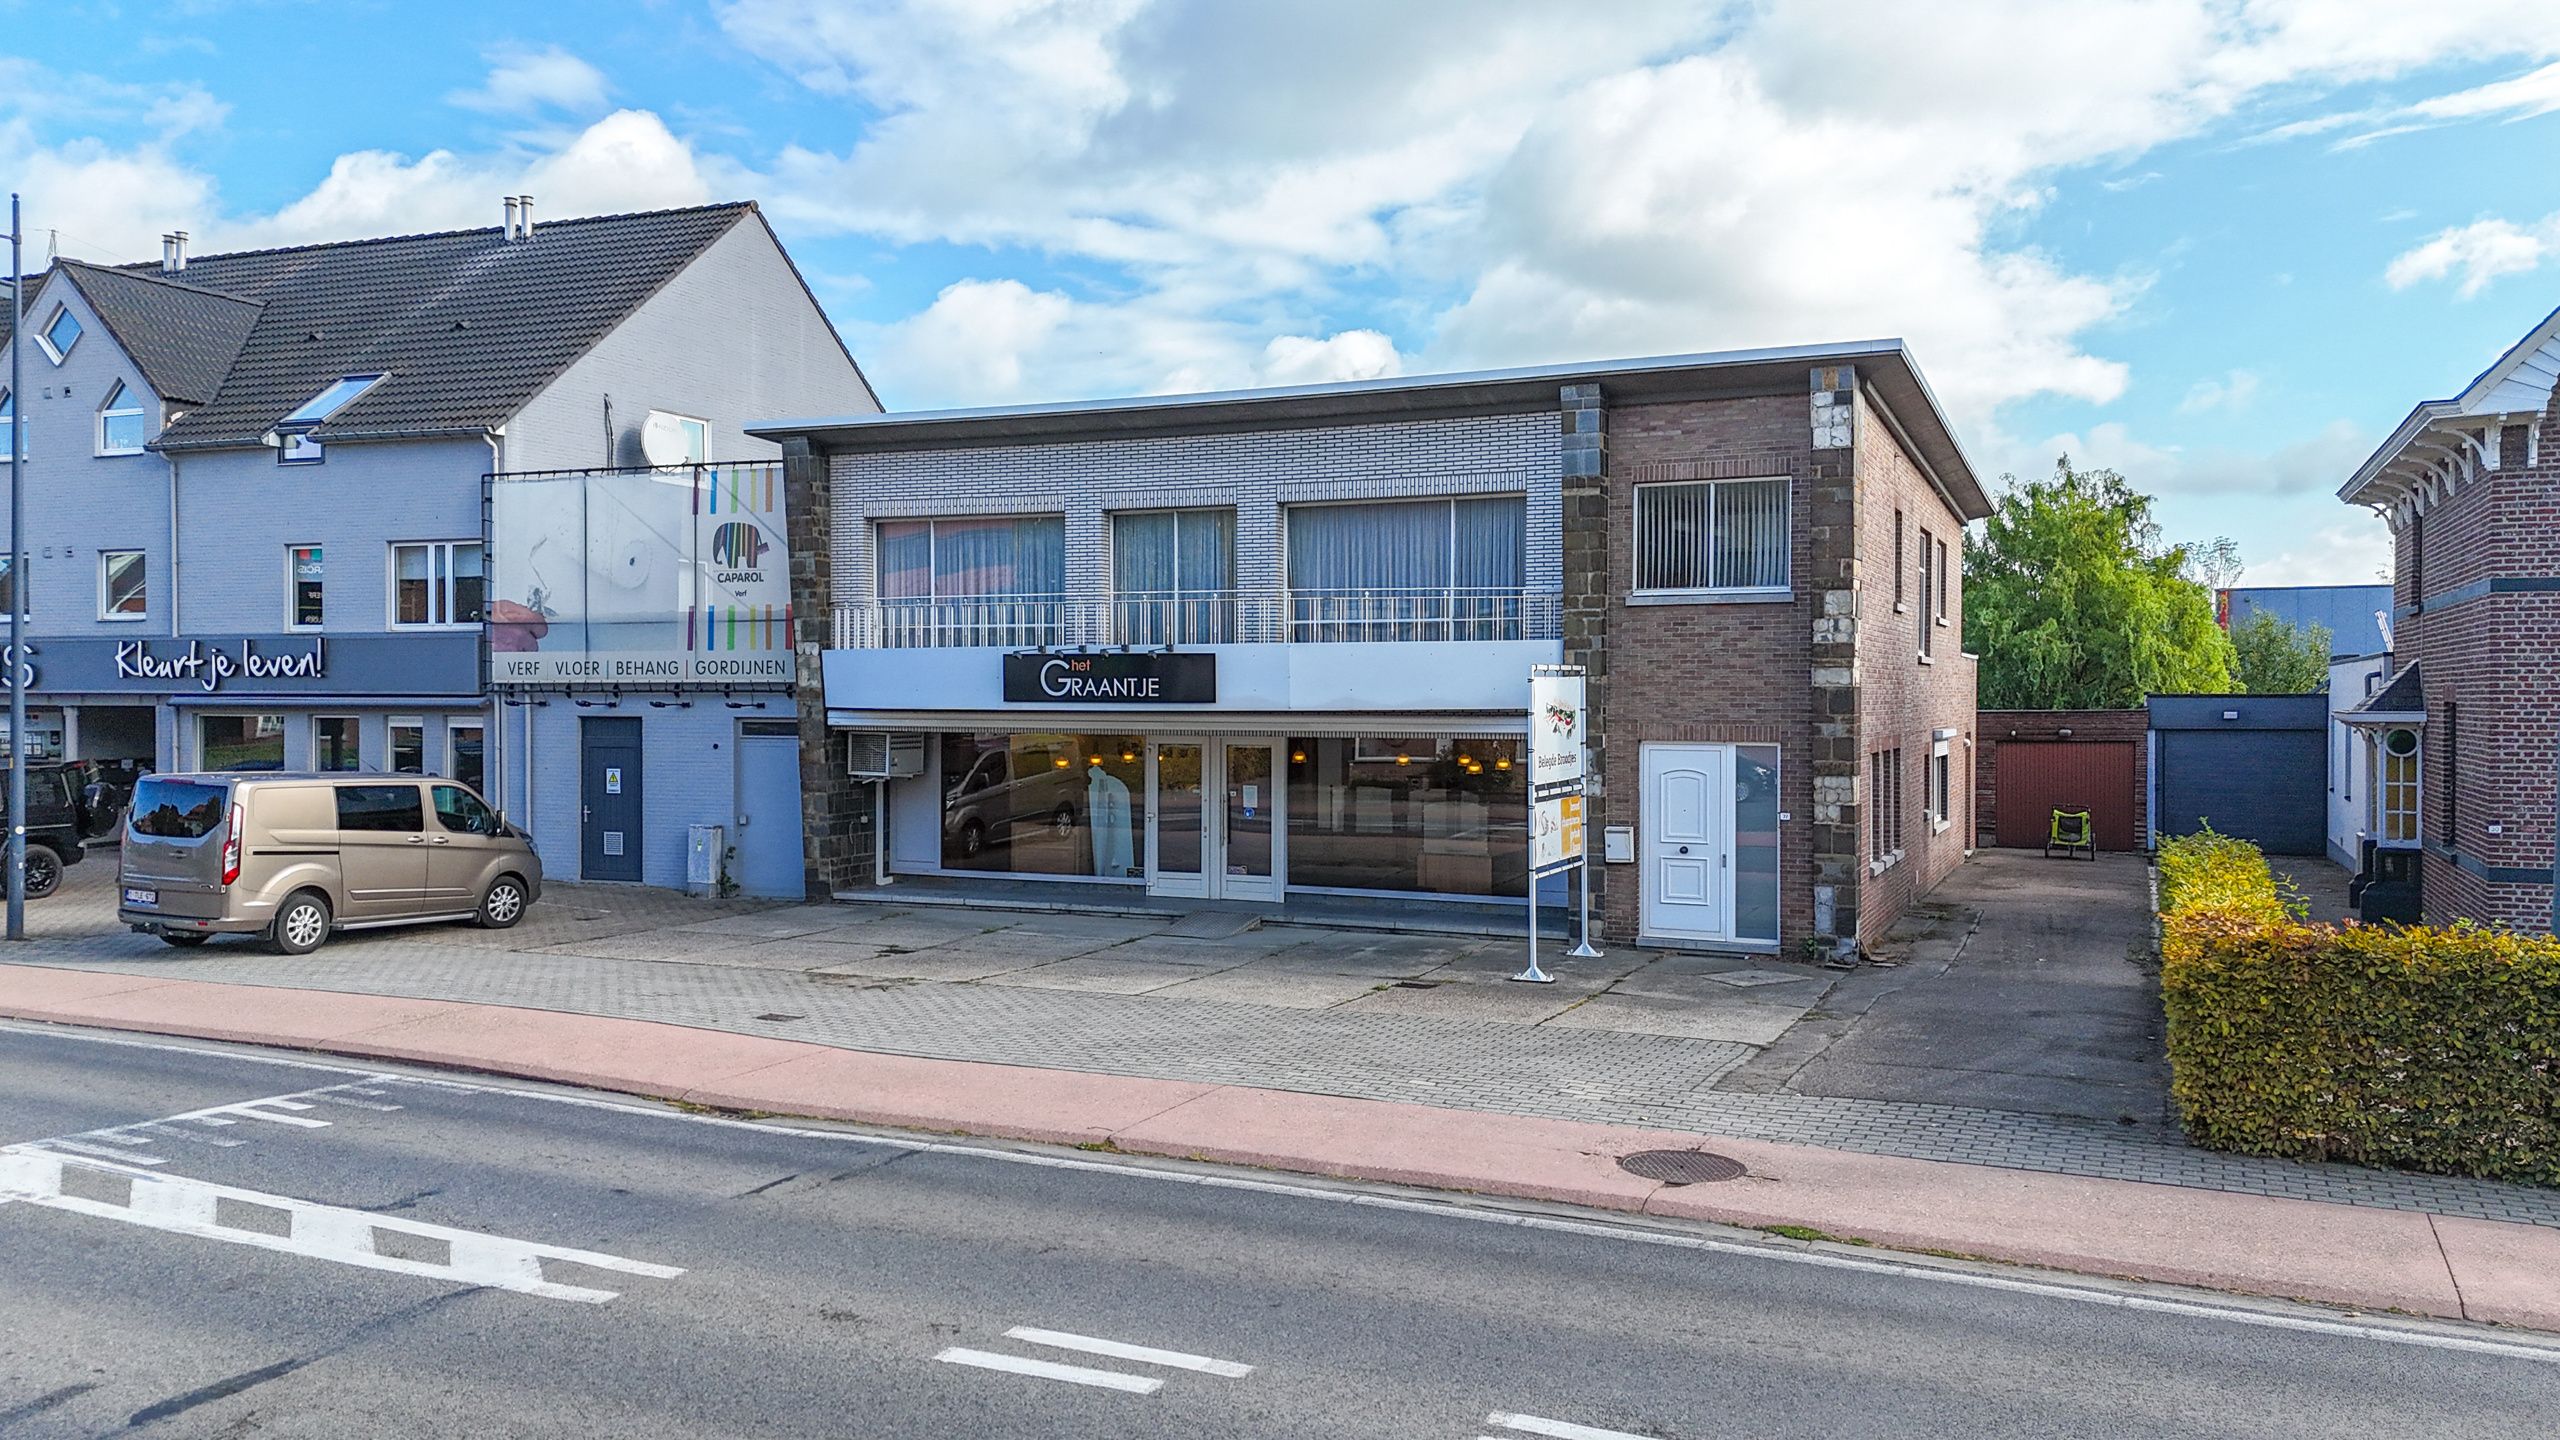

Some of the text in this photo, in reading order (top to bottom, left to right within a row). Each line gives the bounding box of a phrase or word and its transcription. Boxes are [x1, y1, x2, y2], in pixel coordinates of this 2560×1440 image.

[717, 572, 764, 583] CAPAROL
[115, 637, 322, 691] Kleurt je leven!
[507, 660, 785, 676] VERF VLOER BEHANG GORDIJNEN
[1071, 659, 1090, 671] het
[1040, 659, 1160, 697] GRAANTJE
[1538, 751, 1577, 770] Belegde Broodjes
